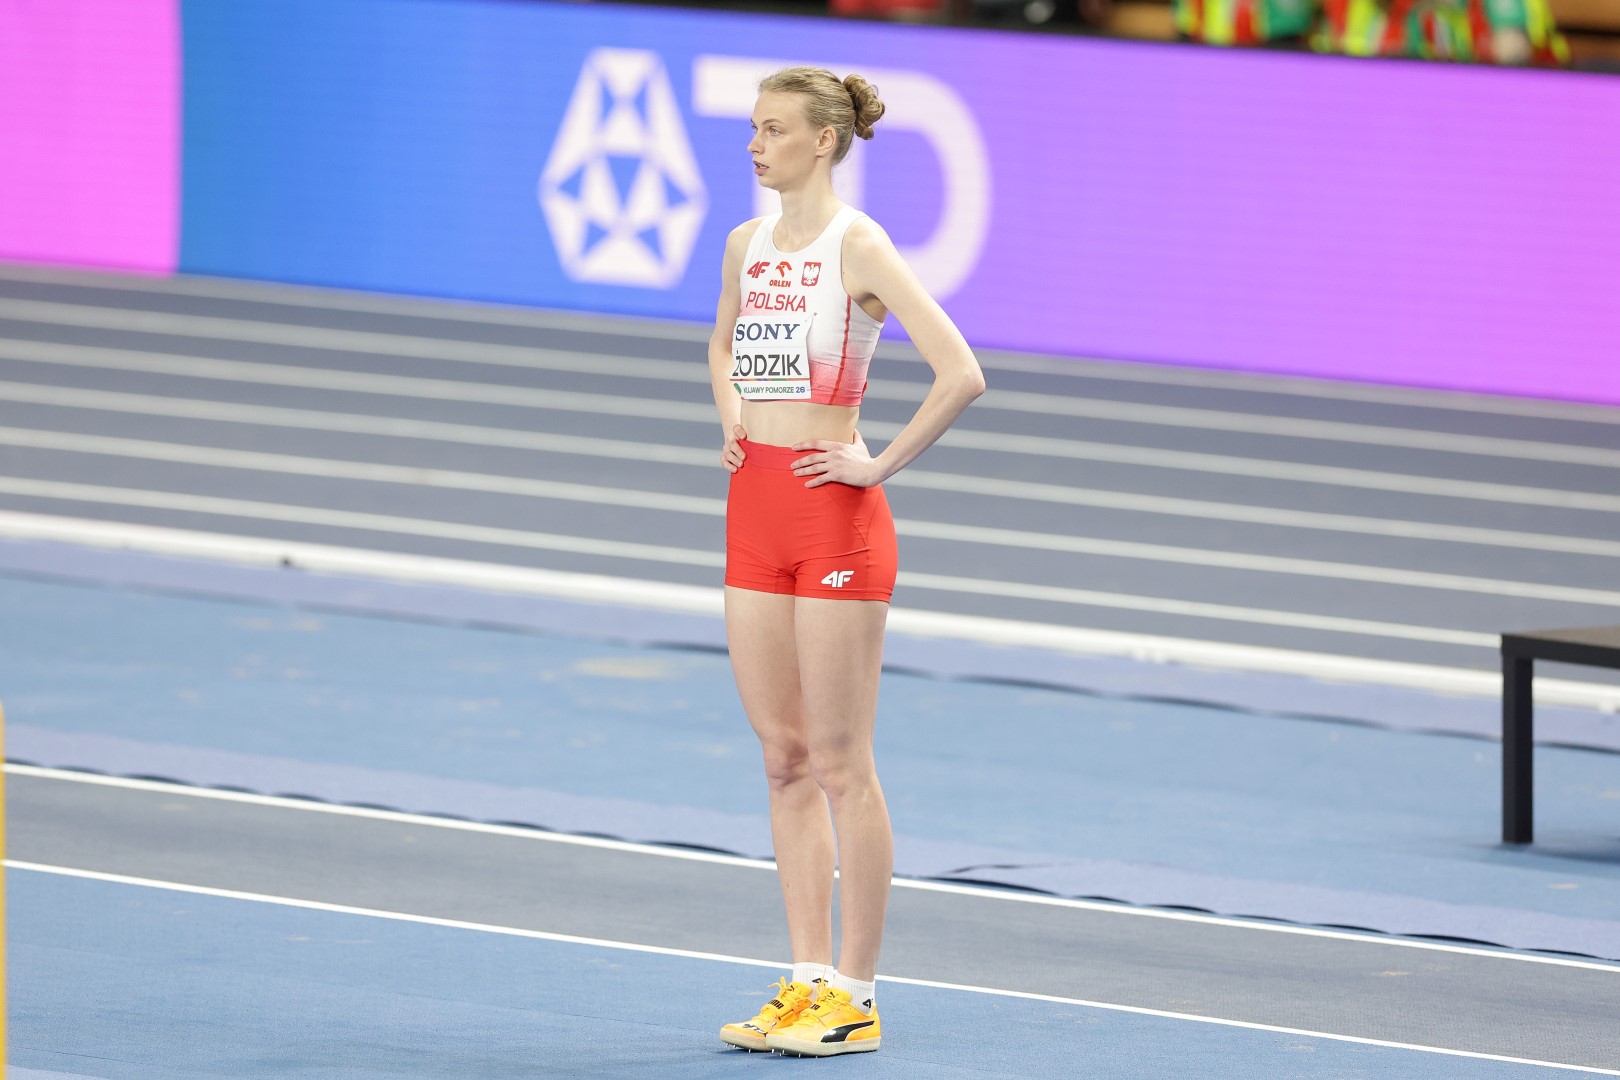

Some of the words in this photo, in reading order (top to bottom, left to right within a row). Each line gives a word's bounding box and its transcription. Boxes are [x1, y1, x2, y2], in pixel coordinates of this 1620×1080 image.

[747, 261, 771, 278] 4F
[769, 279, 791, 287] ORLEN
[745, 291, 806, 312] POLSKA
[735, 322, 800, 341] SONY
[765, 386, 794, 394] POMORZE
[820, 570, 855, 588] 4F
